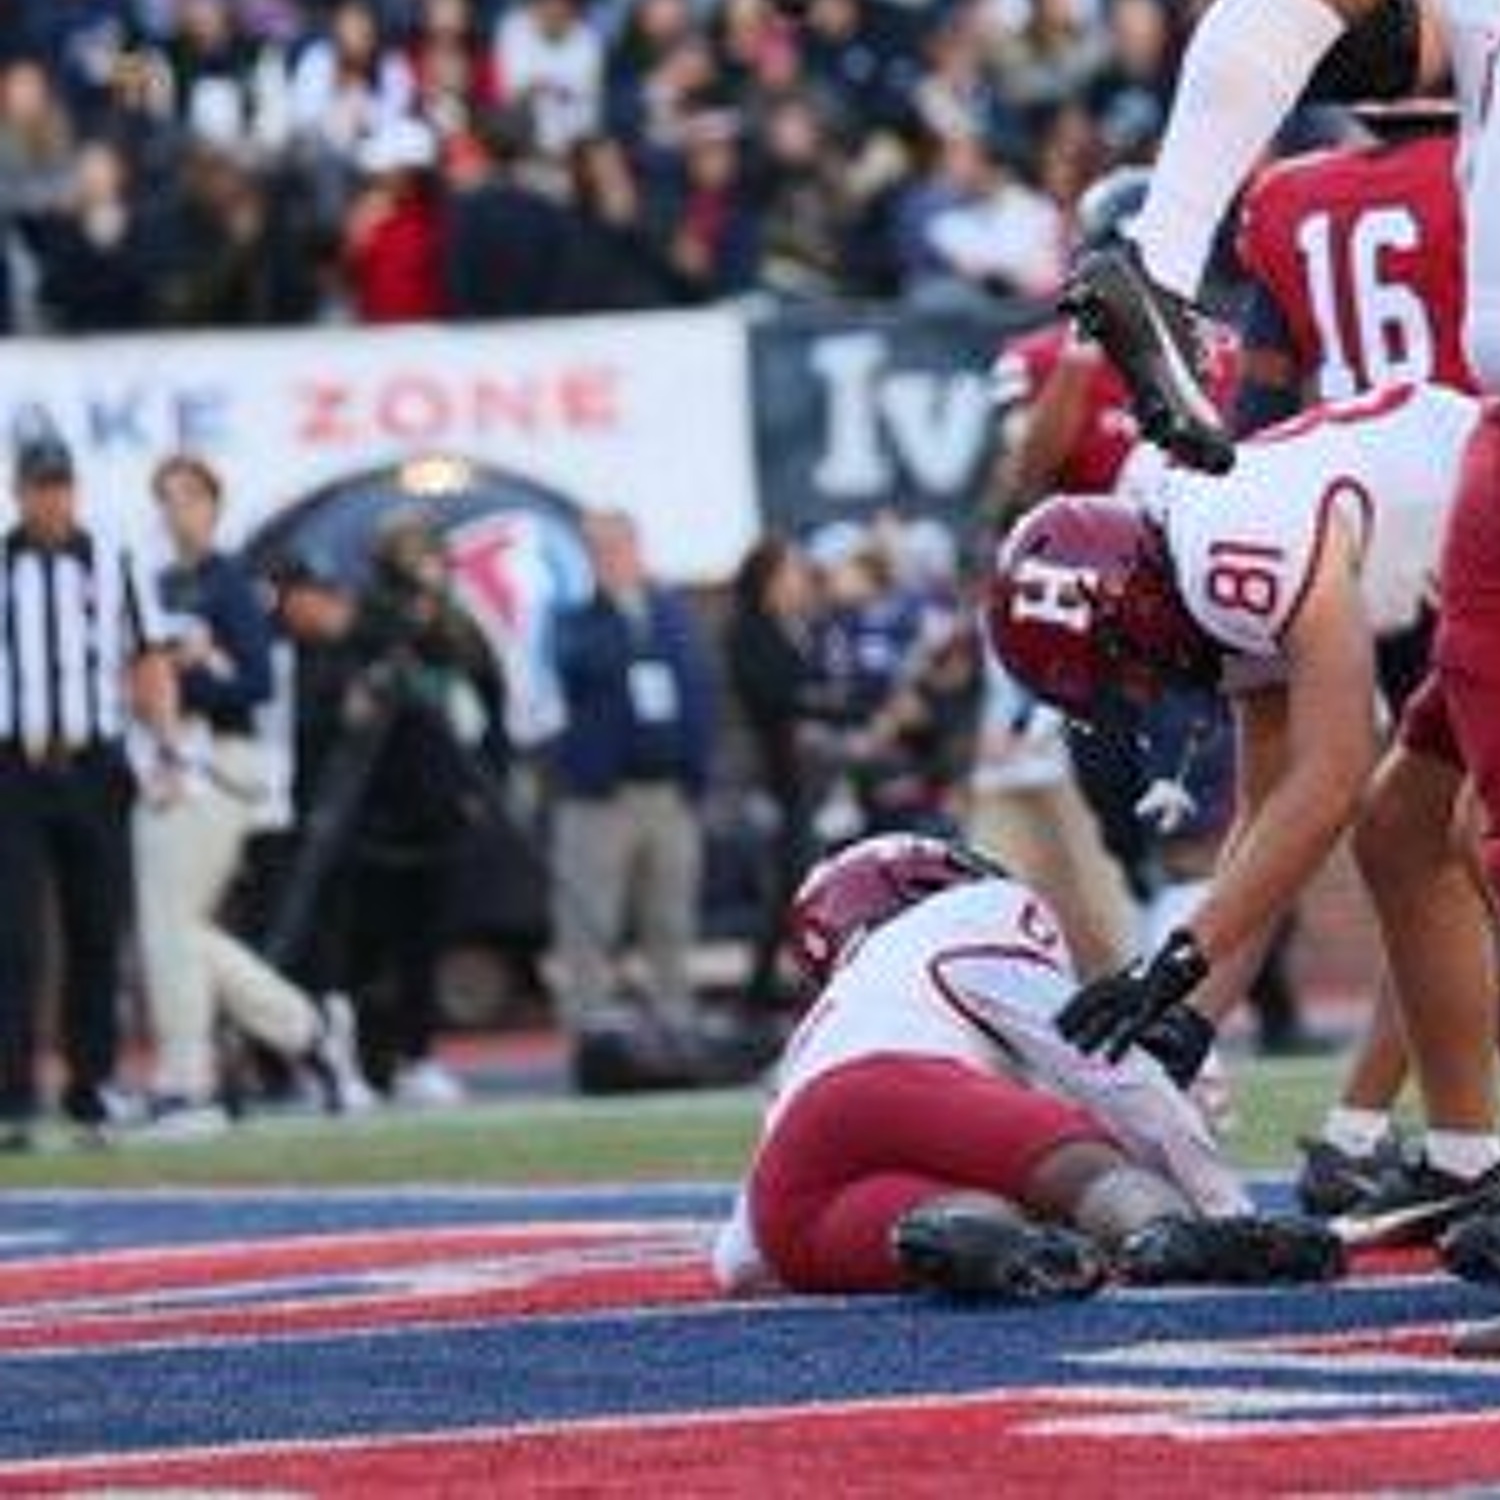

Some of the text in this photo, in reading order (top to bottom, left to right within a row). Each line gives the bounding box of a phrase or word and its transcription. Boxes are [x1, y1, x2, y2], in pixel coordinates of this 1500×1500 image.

[1299, 204, 1435, 400] 16
[295, 364, 624, 446] ZONE
[1010, 558, 1098, 631] H
[1209, 541, 1284, 615] 81
